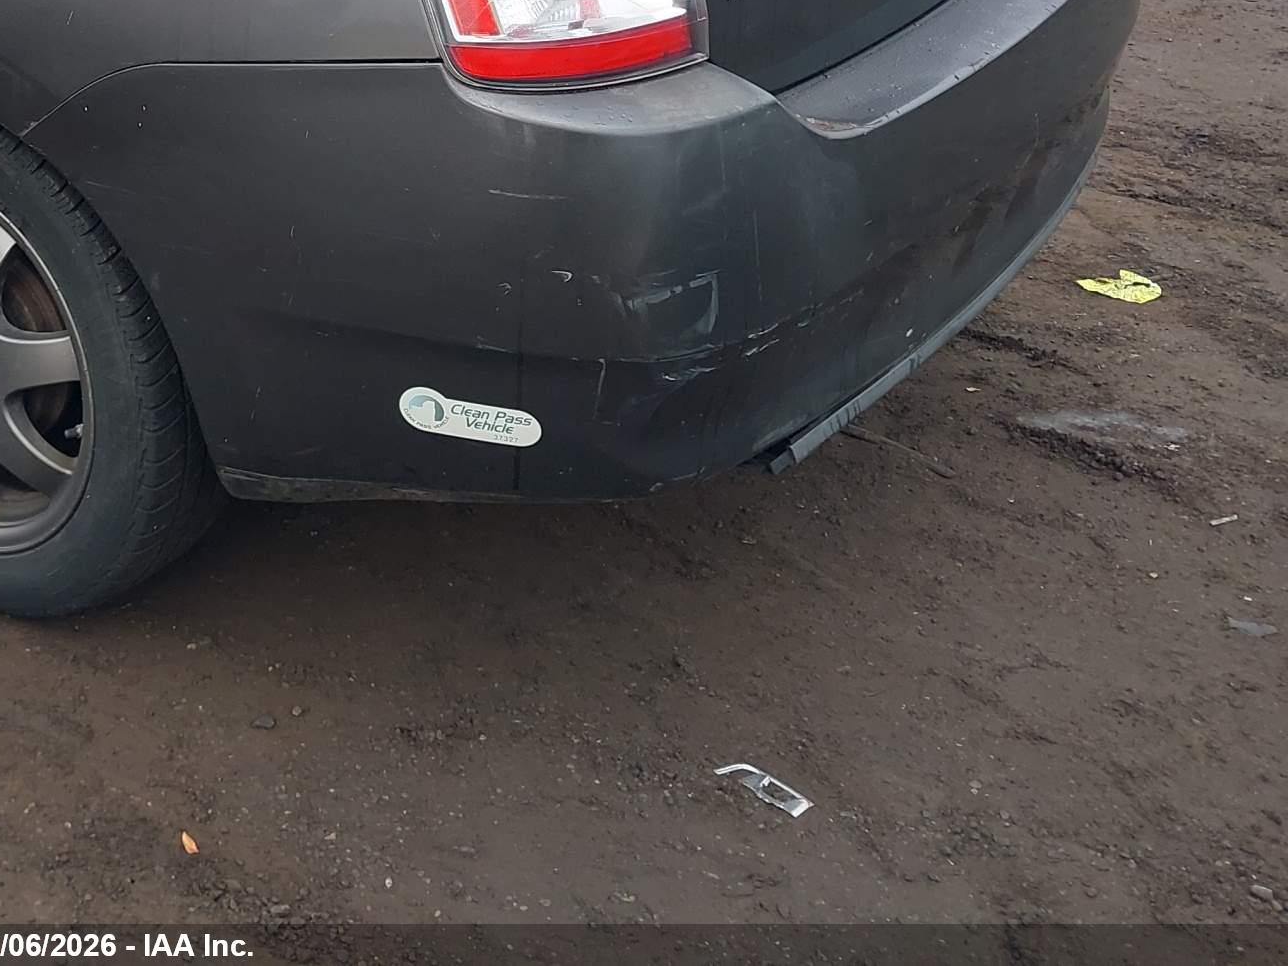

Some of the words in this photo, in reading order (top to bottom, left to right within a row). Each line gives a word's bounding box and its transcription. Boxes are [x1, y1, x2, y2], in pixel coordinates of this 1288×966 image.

[450, 403, 490, 420] Clean
[494, 410, 533, 427] Pass
[465, 417, 515, 435] Vehicle
